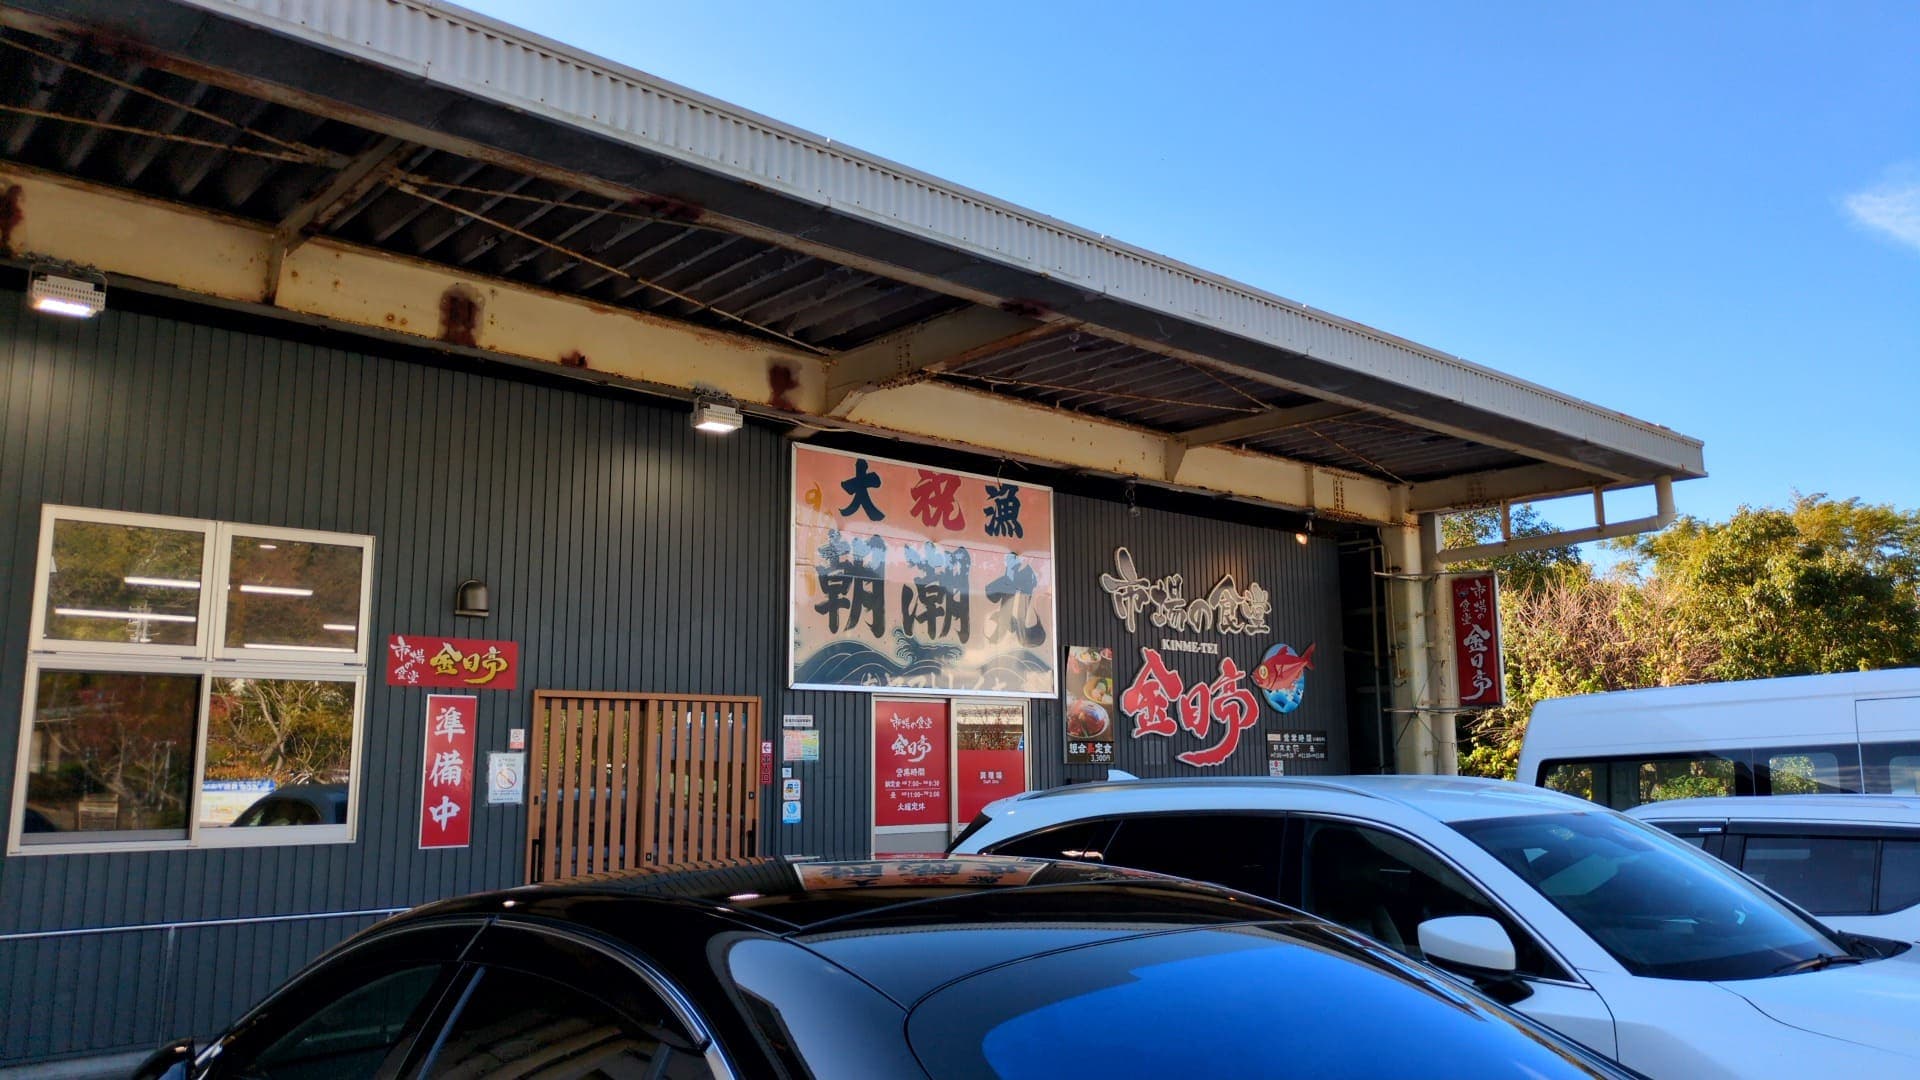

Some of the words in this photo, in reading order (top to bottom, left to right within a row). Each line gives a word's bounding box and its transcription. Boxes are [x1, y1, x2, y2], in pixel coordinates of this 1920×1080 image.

[814, 528, 1047, 648] 朝潮丸
[1099, 546, 1272, 636] 市場の食堂
[429, 641, 508, 685] 金目亭
[1161, 638, 1219, 655] KINME-TEI
[1461, 623, 1493, 700] 金目亭
[891, 734, 932, 763] 金目亭
[1119, 646, 1260, 768] 金目亭
[428, 706, 466, 832] 準備中
